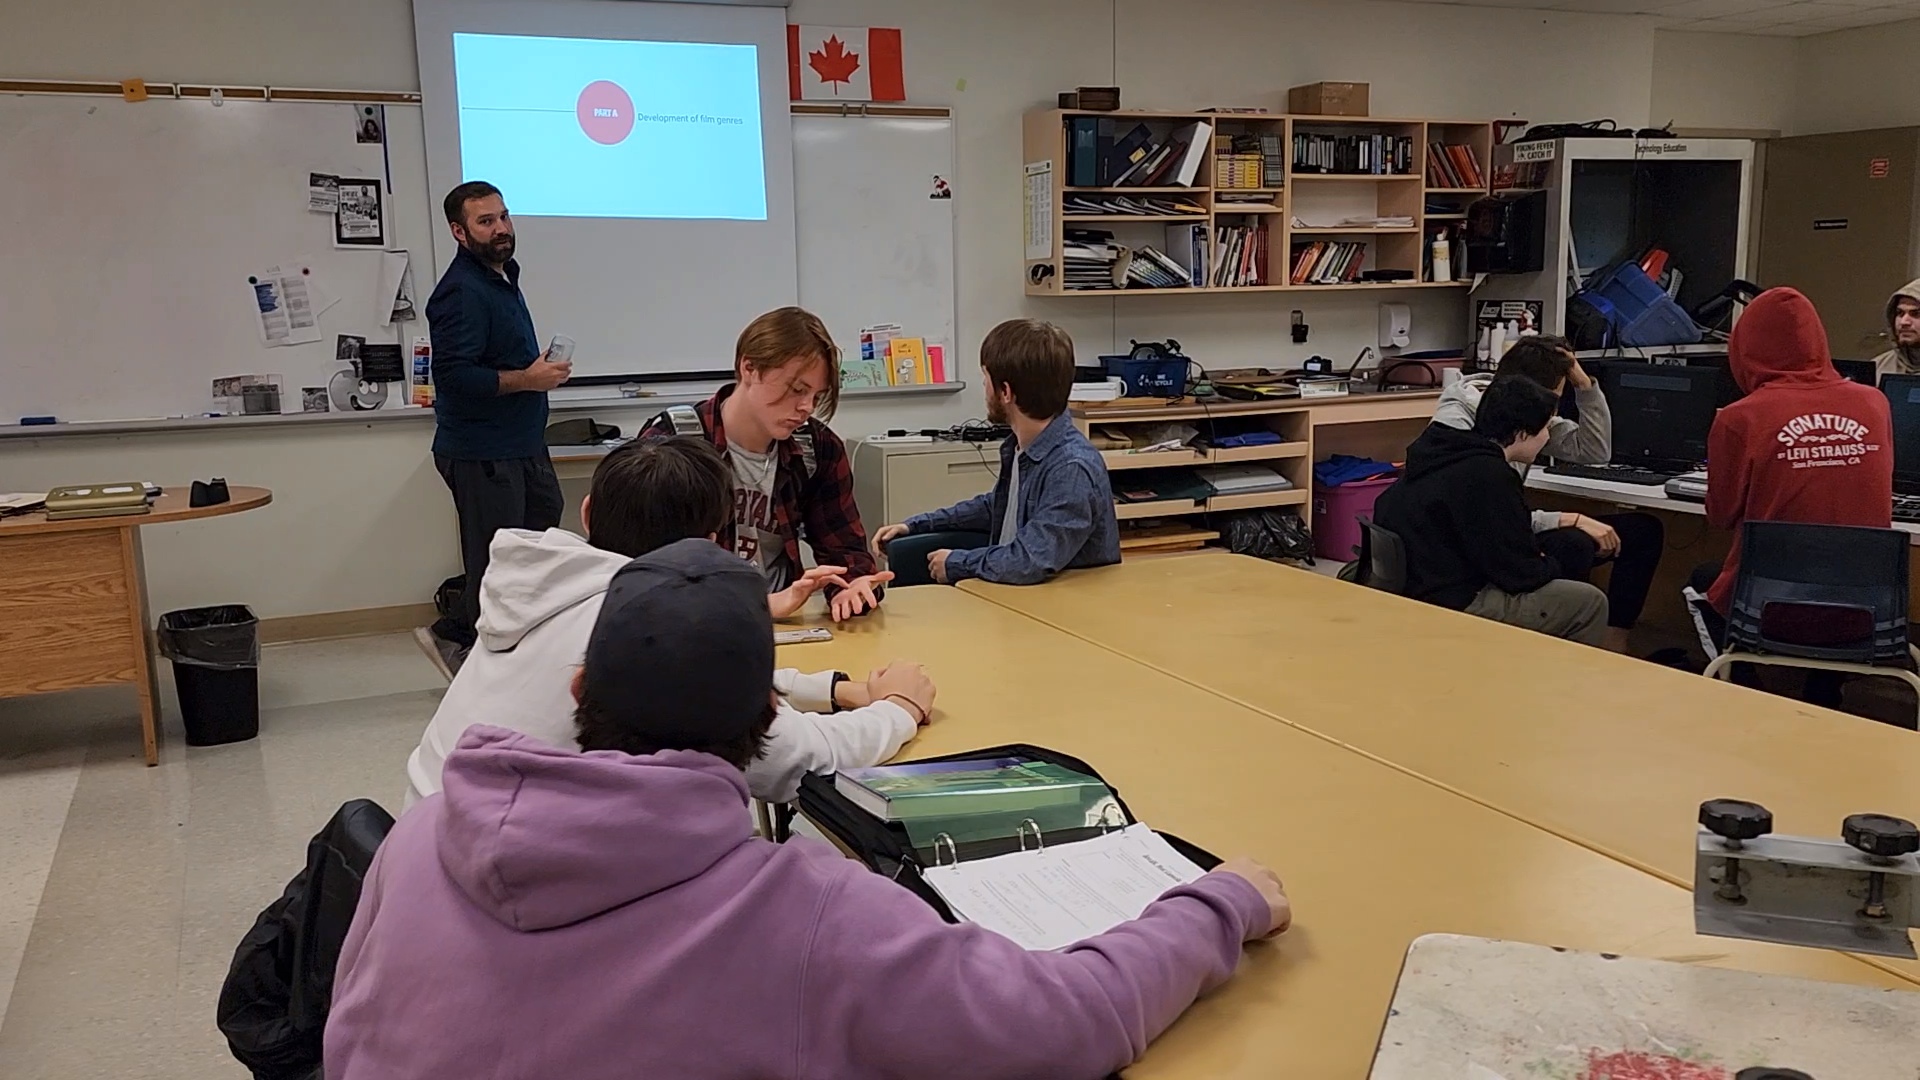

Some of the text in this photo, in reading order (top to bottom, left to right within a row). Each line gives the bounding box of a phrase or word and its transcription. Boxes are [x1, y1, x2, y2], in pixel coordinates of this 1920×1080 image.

[593, 108, 619, 117] PART A
[637, 113, 743, 126] Development of film genres
[1536, 141, 1554, 150] FEVER
[1663, 143, 1687, 153] Education
[1527, 150, 1553, 160] CATCH IT
[1776, 413, 1870, 447] SIGNATURE
[1786, 447, 1810, 461] LEVI
[1811, 443, 1866, 458] STRAUSS
[1792, 457, 1861, 469] San Francisco, CA
